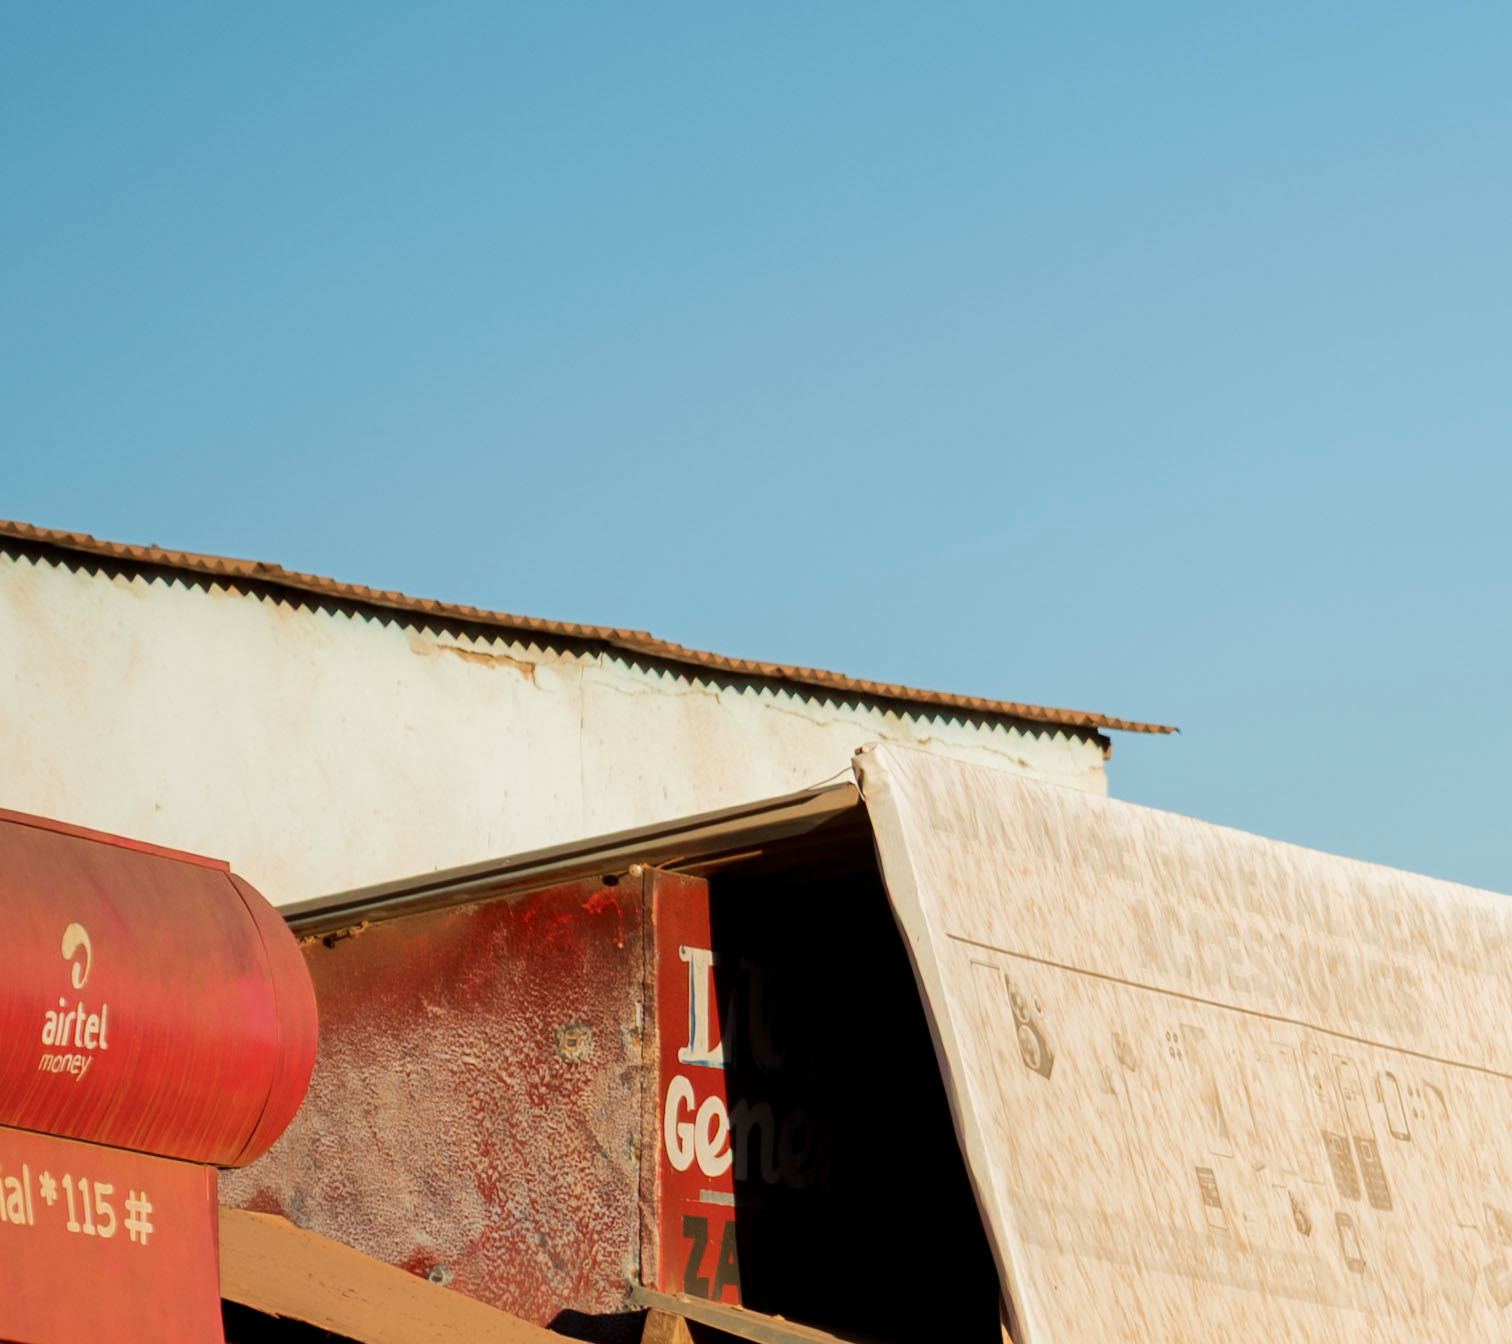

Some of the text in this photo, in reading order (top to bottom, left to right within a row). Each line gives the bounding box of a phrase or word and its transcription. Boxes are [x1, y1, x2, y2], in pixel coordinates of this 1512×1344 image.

[42, 998, 108, 1050] airtel
[39, 1054, 93, 1082] money
[0, 1163, 35, 1226] ial
